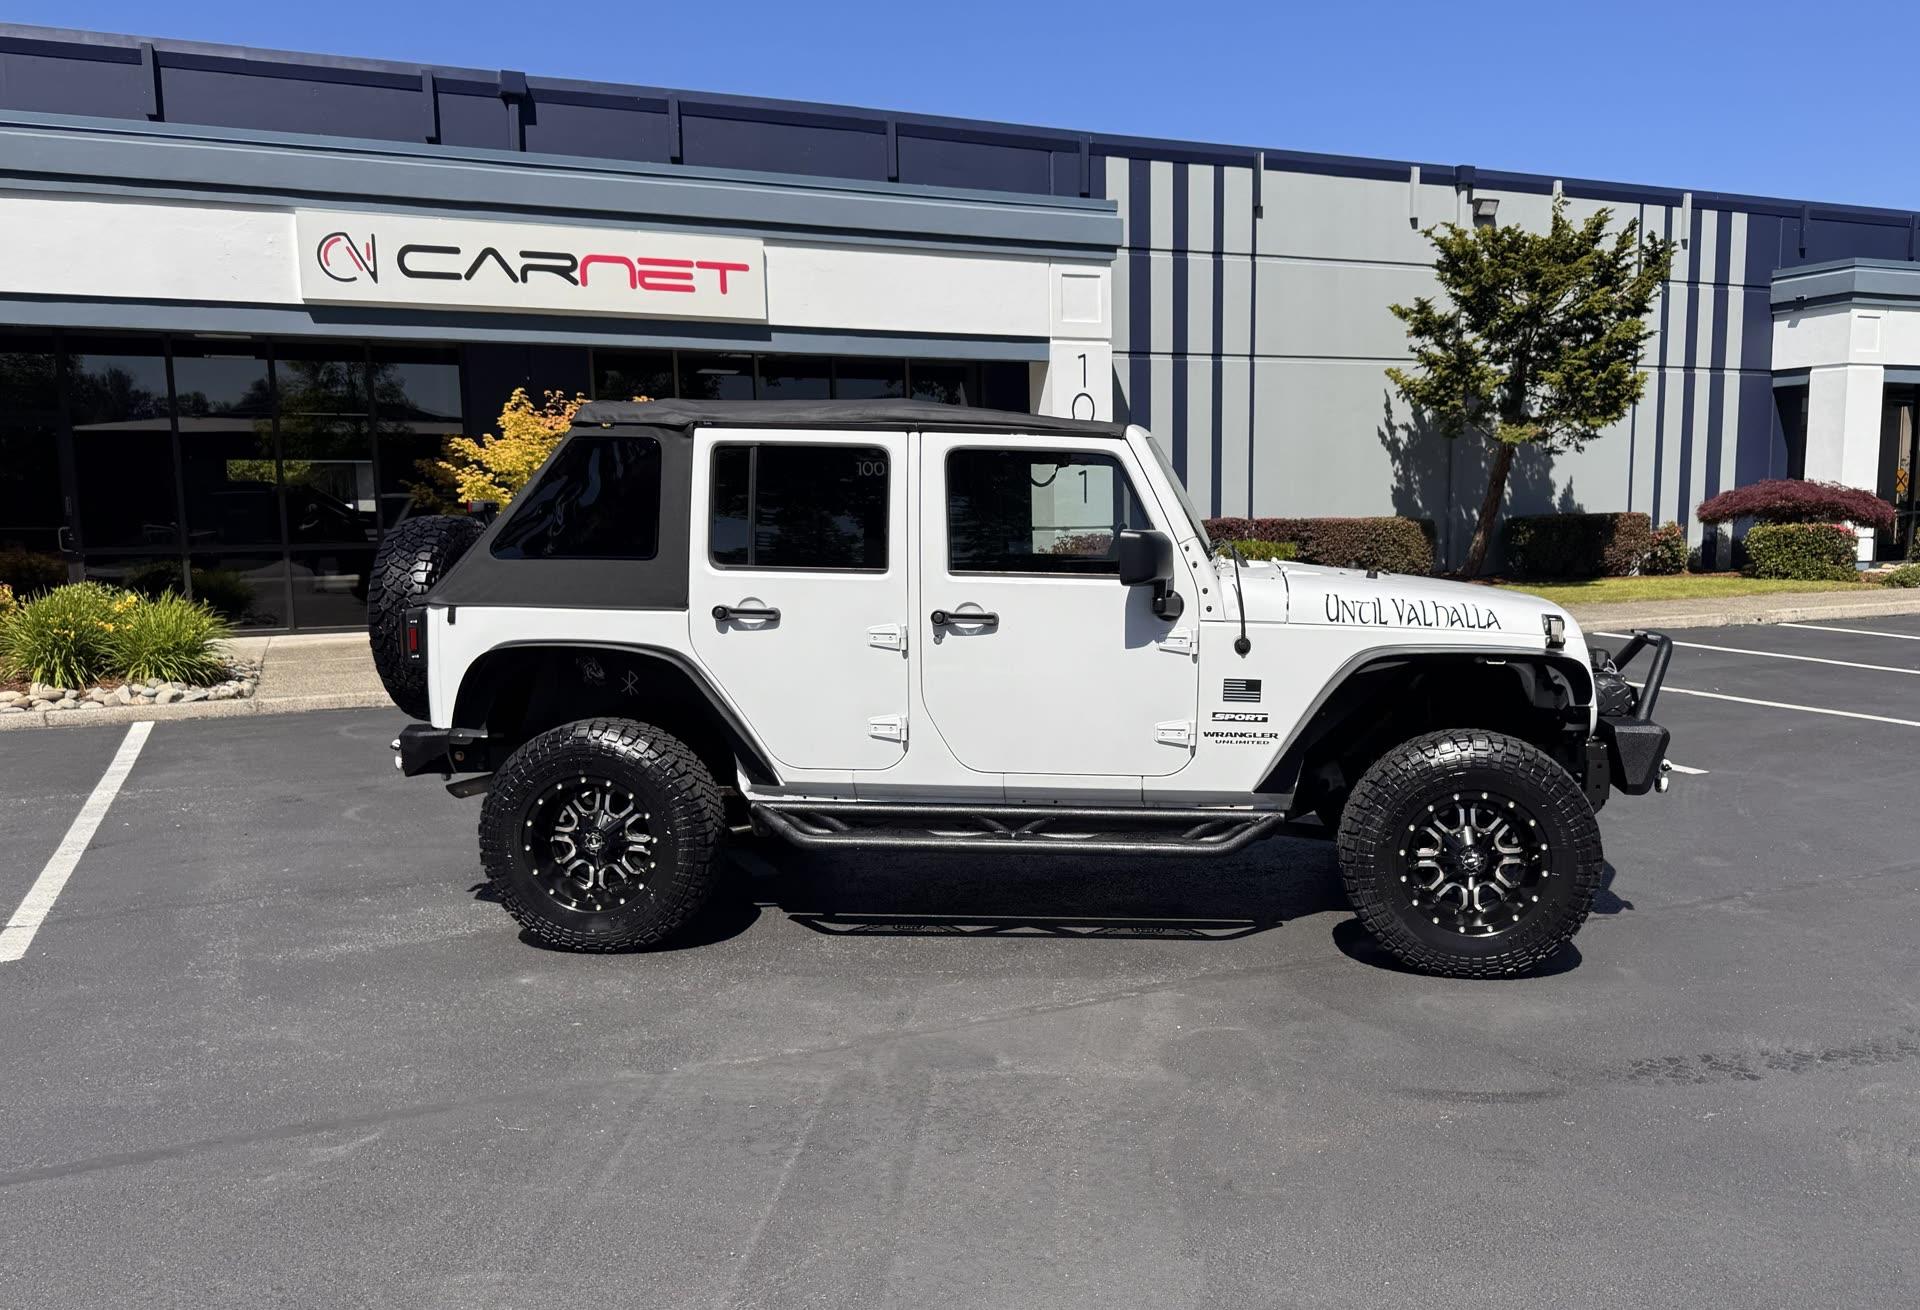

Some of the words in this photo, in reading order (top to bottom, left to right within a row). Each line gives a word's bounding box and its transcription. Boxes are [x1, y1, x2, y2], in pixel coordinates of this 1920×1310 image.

[856, 461, 885, 477] 100
[1213, 712, 1266, 721] SPORT
[1203, 731, 1279, 739] WRANGLER
